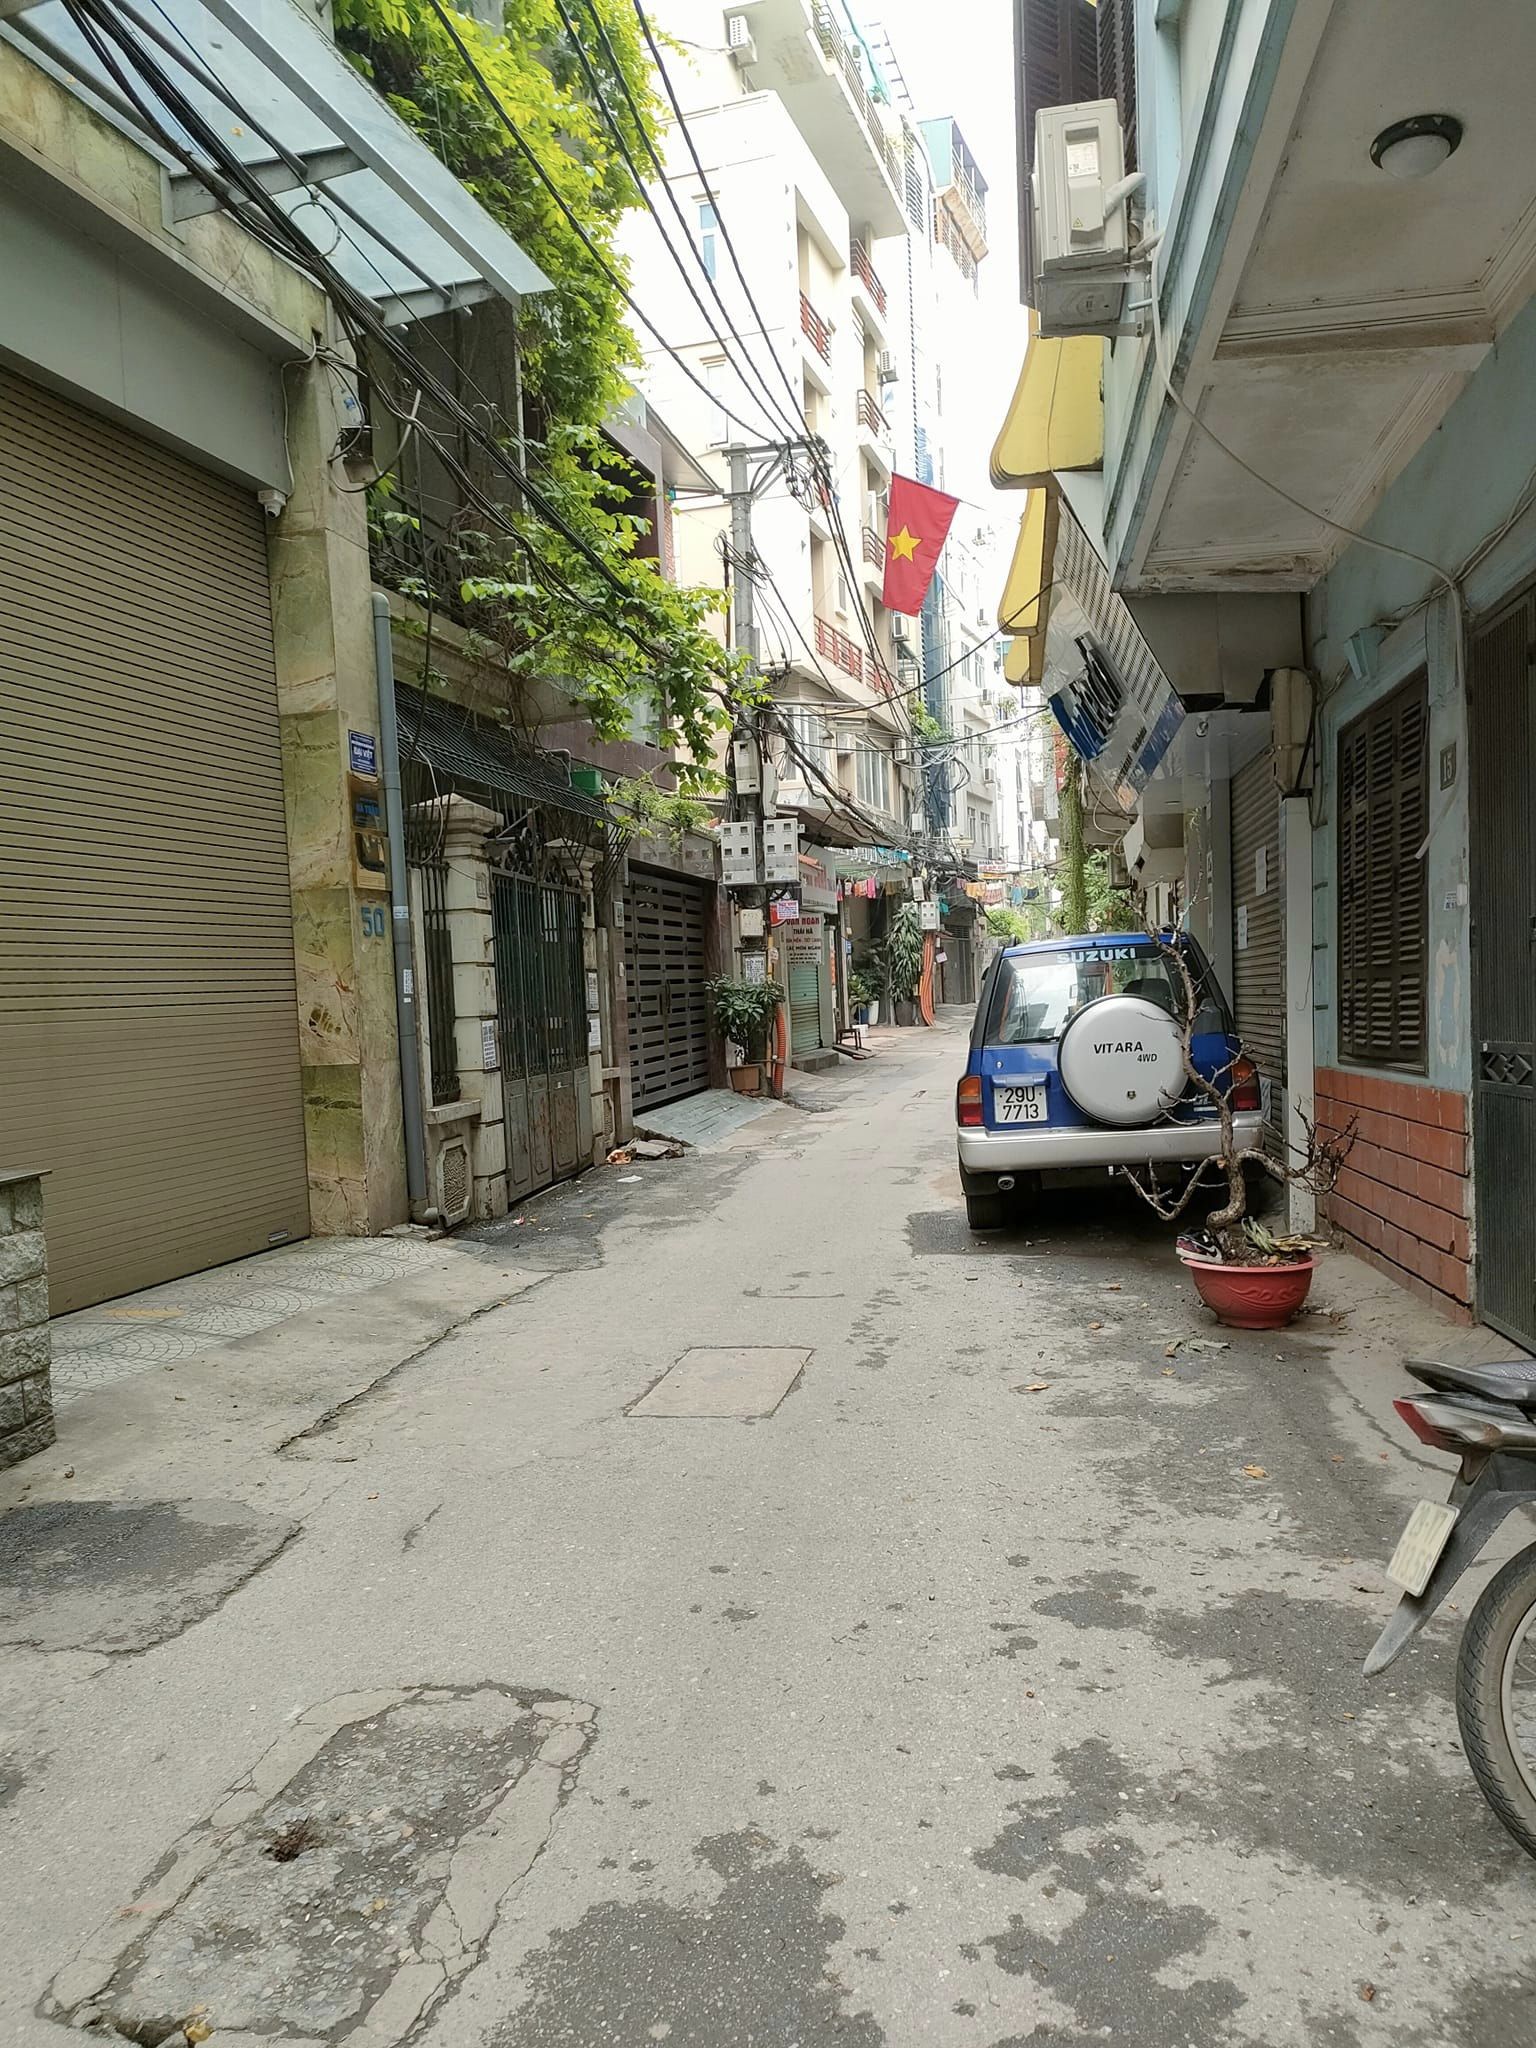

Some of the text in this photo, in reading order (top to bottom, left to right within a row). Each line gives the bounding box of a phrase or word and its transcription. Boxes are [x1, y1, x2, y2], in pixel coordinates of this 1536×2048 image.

[361, 906, 386, 938] 50
[1056, 946, 1136, 964] SUZUKI
[1093, 1041, 1144, 1055] VITARA
[1137, 1053, 1158, 1063] 4WD
[1004, 1086, 1036, 1103] 29U
[1002, 1103, 1039, 1121] 7713
